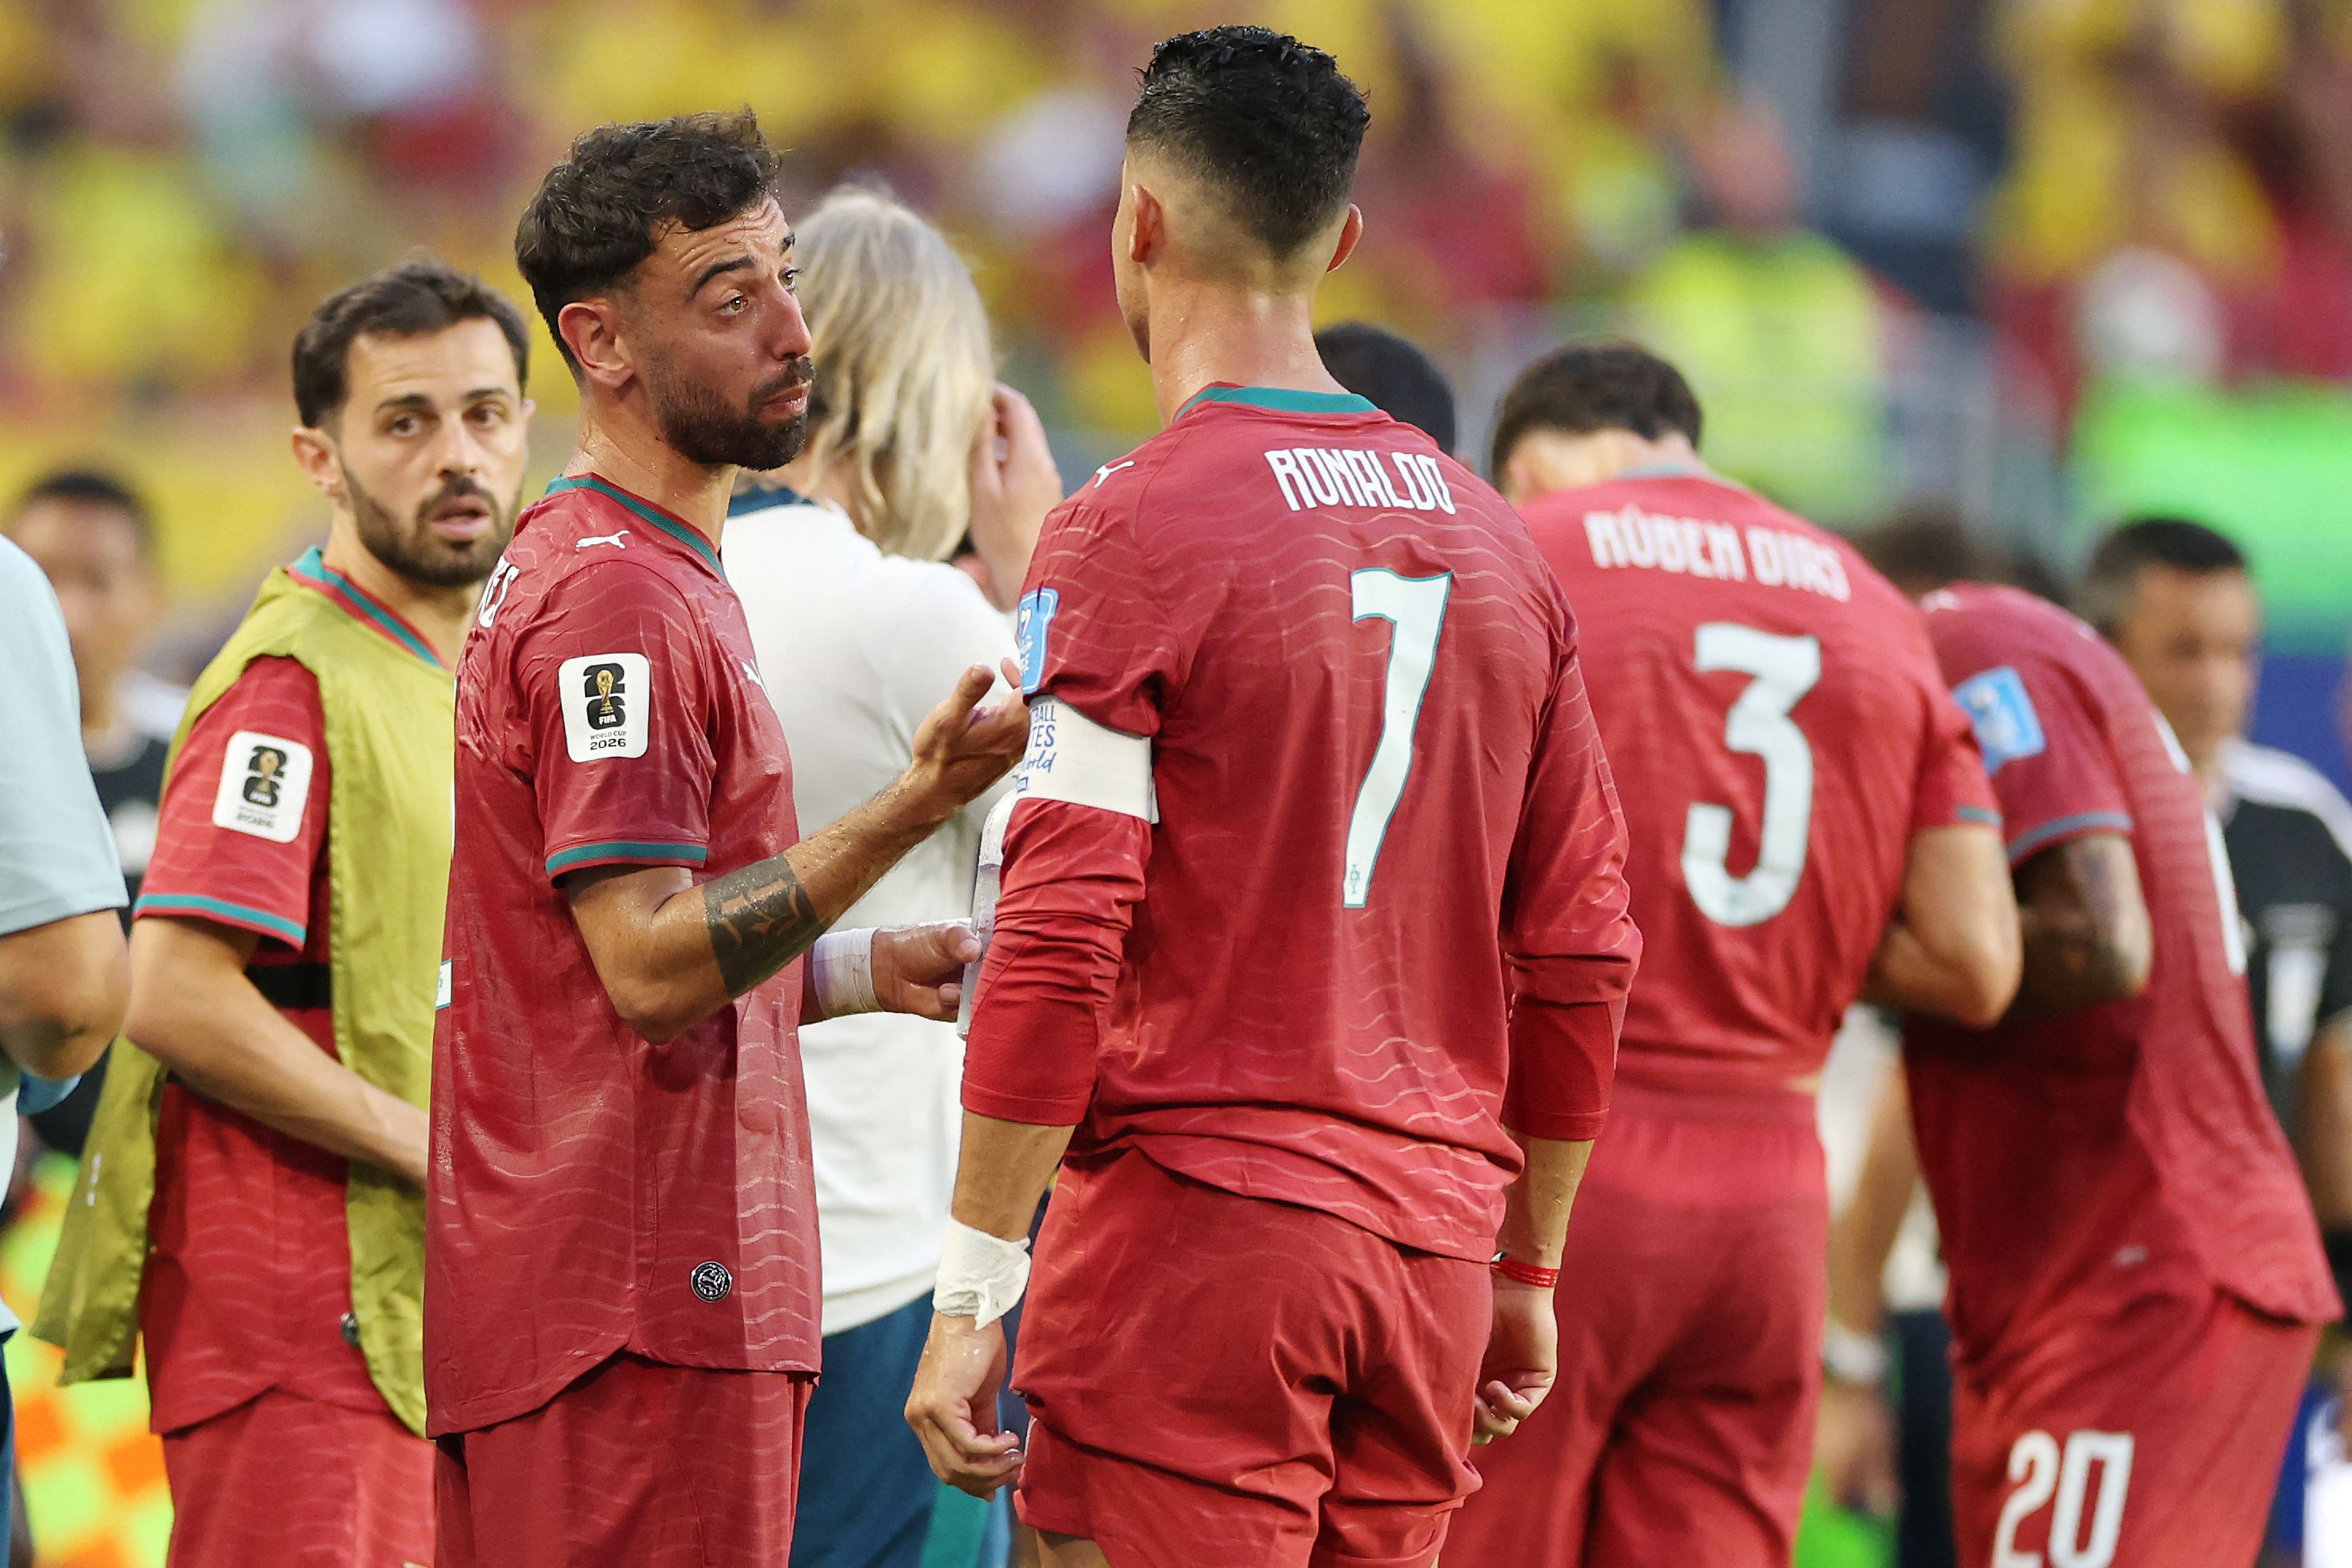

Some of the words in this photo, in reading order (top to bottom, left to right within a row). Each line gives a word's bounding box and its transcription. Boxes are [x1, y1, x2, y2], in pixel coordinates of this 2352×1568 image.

[1264, 448, 1456, 515] RONALDO
[479, 555, 519, 628] ES
[1584, 504, 1748, 582] RÚBEN
[1745, 526, 1850, 602] DIAS
[590, 738, 627, 750] 2026
[599, 714, 617, 725] FIFA
[1343, 567, 1452, 908] 7
[1681, 623, 1821, 927] 3
[1992, 1429, 2135, 1568] 20
